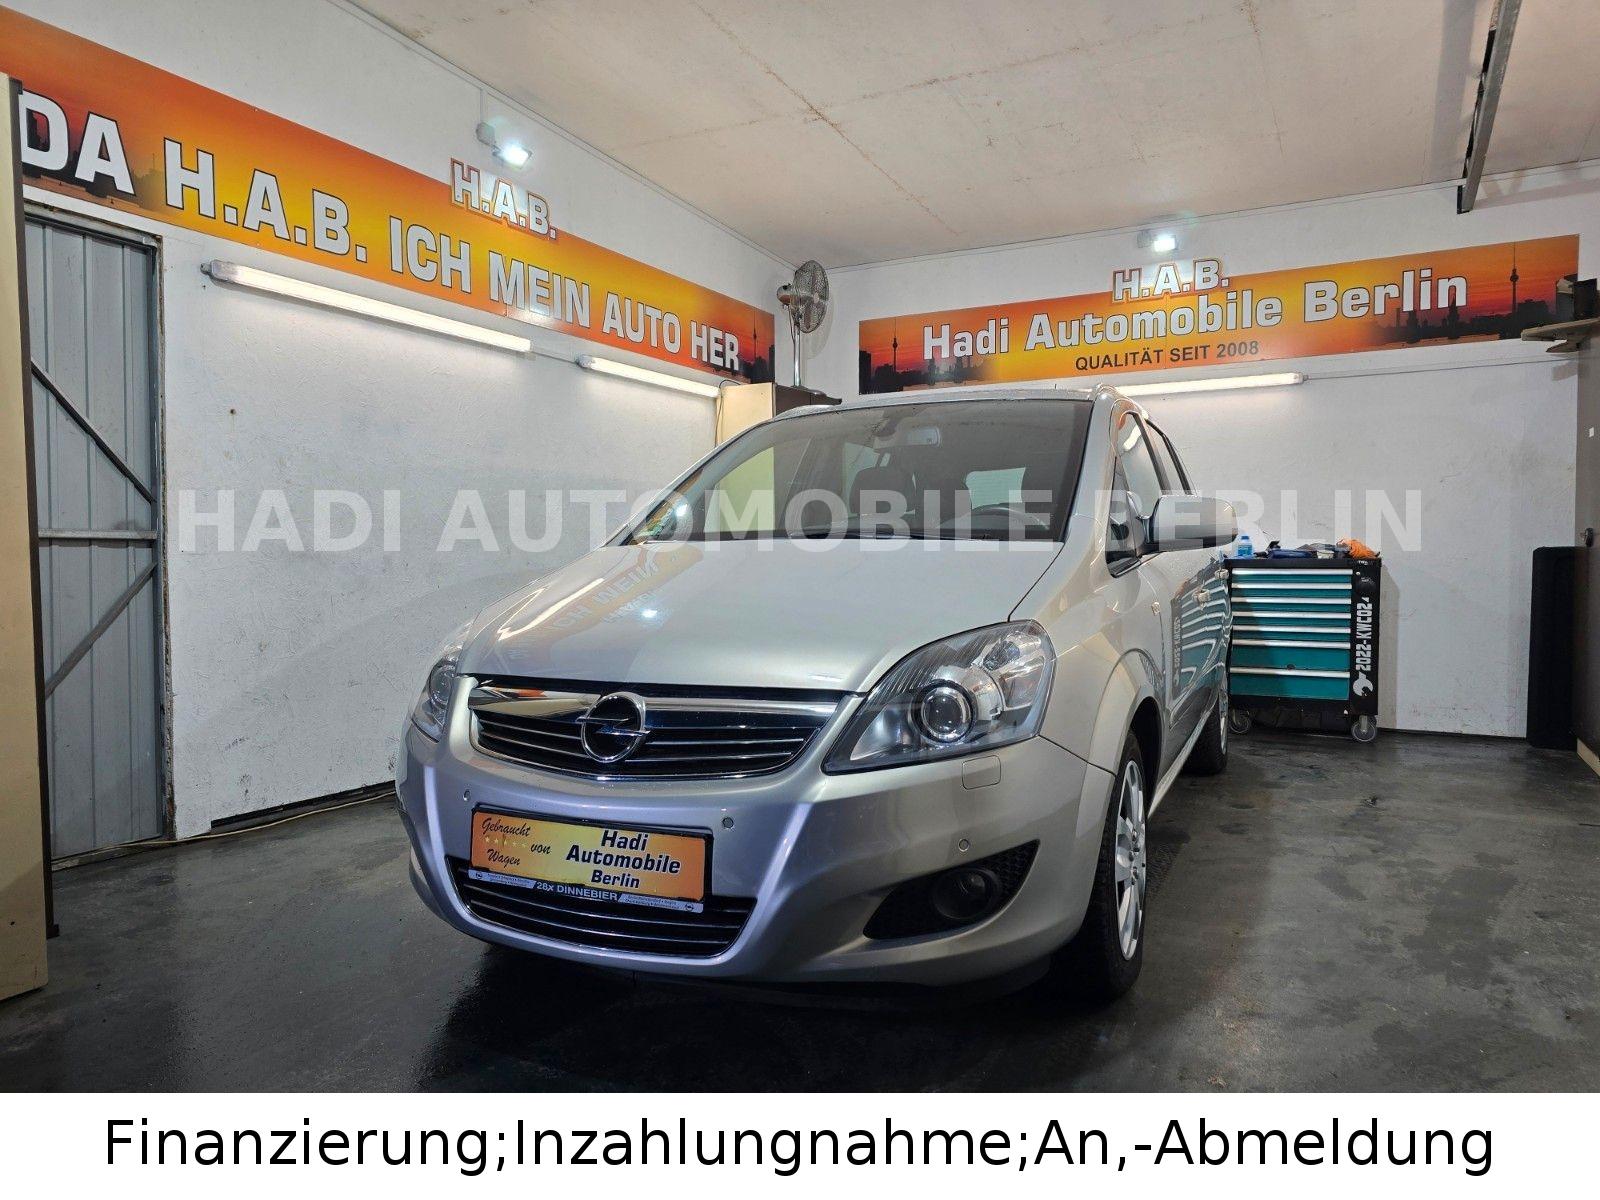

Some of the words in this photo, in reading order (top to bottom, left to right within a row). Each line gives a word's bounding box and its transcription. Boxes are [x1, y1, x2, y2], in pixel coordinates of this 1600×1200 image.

[451, 159, 557, 240] H.A.B.
[18, 89, 136, 195] DA
[164, 137, 367, 263] H.A.B.
[389, 215, 471, 293] ICH
[488, 250, 591, 329] MEIN
[602, 291, 681, 354] AUTO
[690, 320, 739, 371] HER
[1113, 259, 1230, 301] H.A.B.
[922, 318, 1010, 360] Hadi
[1024, 289, 1283, 352] Automobile
[1303, 268, 1468, 323] Berlin
[1075, 349, 1163, 371] QUALITÄT
[1170, 344, 1211, 362] SEIT
[1216, 340, 1259, 359] 2008
[481, 818, 531, 837] Gebraucht
[600, 829, 650, 851] Hadi
[486, 848, 521, 868] Wagen
[530, 843, 552, 855] von
[566, 844, 681, 875] Automobile
[591, 869, 640, 889] Berlin
[556, 885, 618, 901] DINNEBIER
